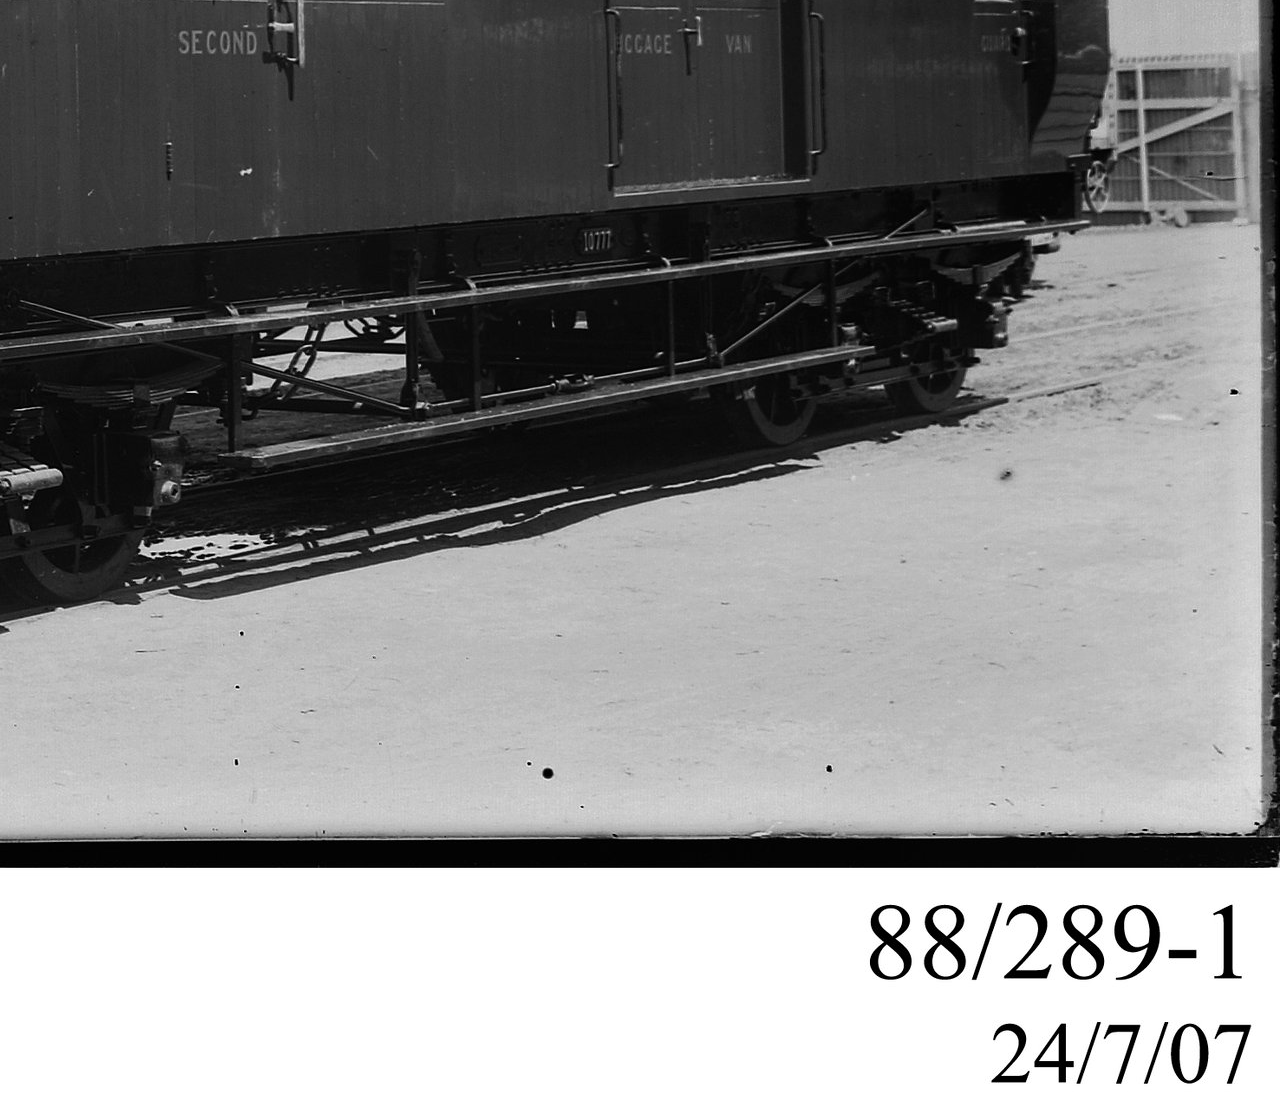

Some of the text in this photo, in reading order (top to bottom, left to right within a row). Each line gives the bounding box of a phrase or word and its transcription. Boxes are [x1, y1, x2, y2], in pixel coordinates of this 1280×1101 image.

[178, 29, 258, 56] SECOND
[618, 33, 753, 55] GGAGE VAN
[583, 230, 612, 252] 10777
